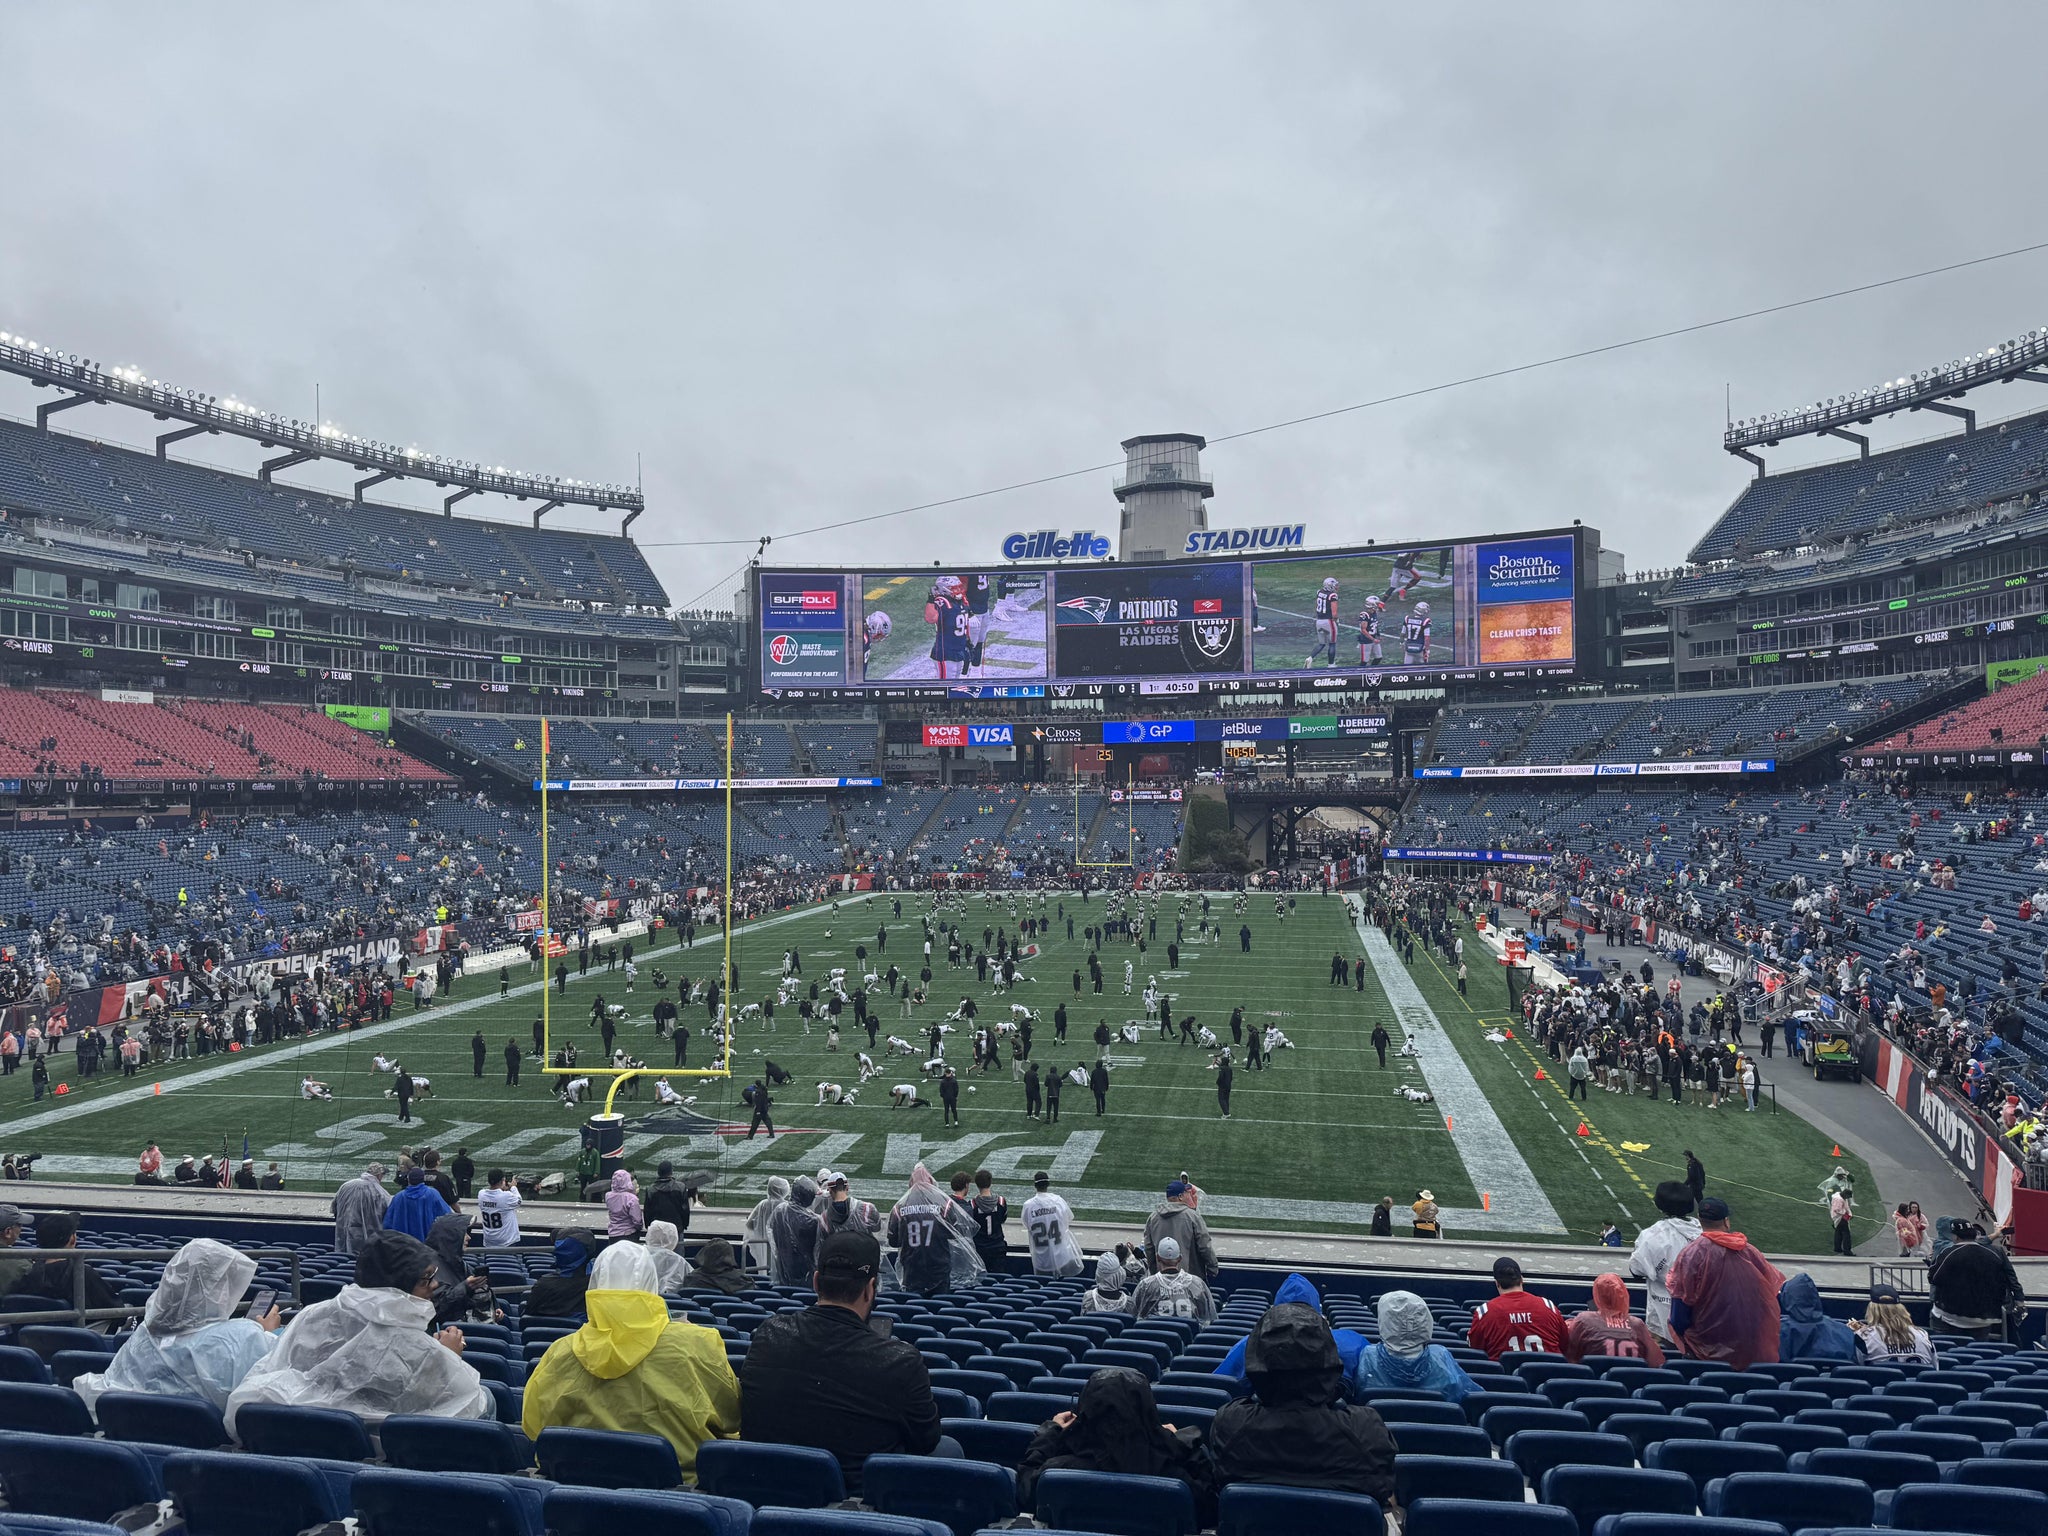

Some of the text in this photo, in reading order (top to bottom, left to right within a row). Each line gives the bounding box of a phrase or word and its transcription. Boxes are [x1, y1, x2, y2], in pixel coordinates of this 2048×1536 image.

[1184, 526, 1304, 552] STADIUM
[1002, 531, 1110, 559] Gillette
[1499, 555, 1544, 569] Boston
[1489, 559, 1561, 580] Scientific
[1491, 580, 1519, 588] Advancing
[2004, 576, 2029, 588] evolv
[773, 596, 831, 604] SUFFOLK
[89, 609, 117, 619] evolv
[1118, 600, 1179, 620] PATRIOTS
[1752, 620, 1776, 630] evolv
[1997, 620, 2015, 632] LIONS
[1119, 625, 1179, 636] LAS VEGAS
[1489, 626, 1562, 639] CLEAN CRISP TASTE
[1119, 634, 1180, 647] RAIDERS
[1924, 631, 1949, 643] PACKERS
[23, 641, 53, 654] RAVENS
[1750, 653, 1779, 664] LIVE ODDS
[252, 663, 270, 674] RAMS
[1536, 668, 1543, 676] 0
[331, 671, 353, 681] TEXANS
[1391, 675, 1409, 683] 0:00
[1441, 673, 1447, 681] 0
[1165, 682, 1195, 692] 40:50
[1208, 681, 1240, 690] 1ST 10
[1278, 679, 1290, 688] 35
[1313, 678, 1347, 687] Gillette
[491, 684, 509, 692] BEARS
[562, 688, 585, 697] VIKINGS
[993, 686, 1029, 696] NE 0
[1089, 685, 1126, 694] LV 0
[787, 690, 804, 698] 0:00
[832, 690, 838, 698] 0
[1338, 718, 1386, 727] J.DERENZO
[937, 726, 960, 736] CVS
[969, 727, 1012, 743] VISA
[1222, 722, 1262, 737] jetBlue
[1301, 725, 1335, 734] paycom
[1099, 751, 1112, 760] 25
[1226, 747, 1256, 758] 40:50
[2011, 752, 2033, 762] Gillette
[1747, 762, 1768, 770] FASTENAL
[1861, 757, 1874, 767] 0:00
[1422, 768, 1453, 776] FASTENAL
[1601, 765, 1633, 774] FASTENAL
[66, 781, 99, 793] LV 0
[189, 782, 198, 792] 10
[227, 783, 236, 791] 35
[252, 783, 276, 791] Gillette
[318, 782, 334, 791] 0:00
[321, 937, 400, 968] ENGLAND
[1919, 1078, 1977, 1171] PATRIOTS
[900, 1204, 941, 1217] GRONKOWSKI
[482, 1211, 503, 1229] 98
[985, 1215, 993, 1236] 1
[907, 1219, 935, 1248] 87
[1031, 1219, 1062, 1248] 24
[1509, 1312, 1533, 1325] MAYE
[1606, 1316, 1632, 1330] MAYE
[1508, 1334, 1545, 1352] 10
[1605, 1338, 1639, 1358] 10
[1887, 1342, 1917, 1355] BRADY
